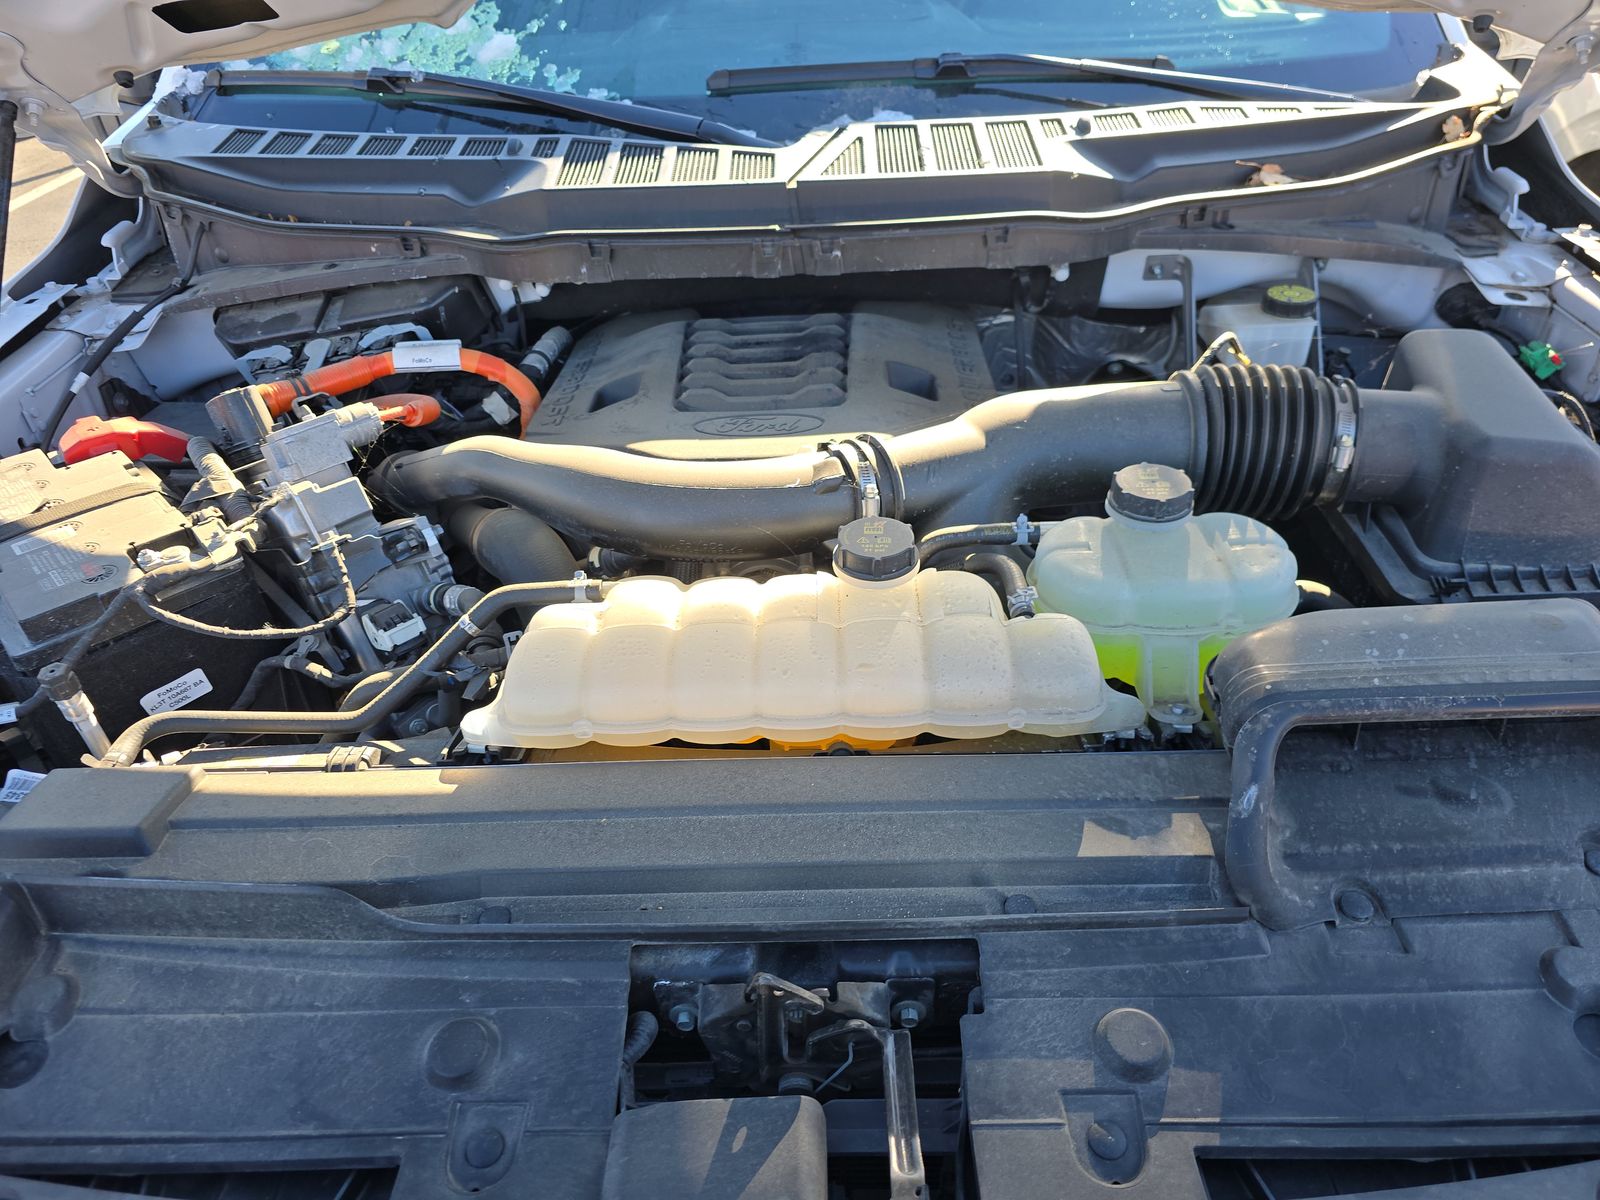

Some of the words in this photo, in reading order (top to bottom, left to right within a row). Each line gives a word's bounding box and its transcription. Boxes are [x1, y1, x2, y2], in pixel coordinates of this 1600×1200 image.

[716, 417, 800, 432] Ford
[157, 680, 188, 698] FoMoCo
[193, 679, 205, 688] BA
